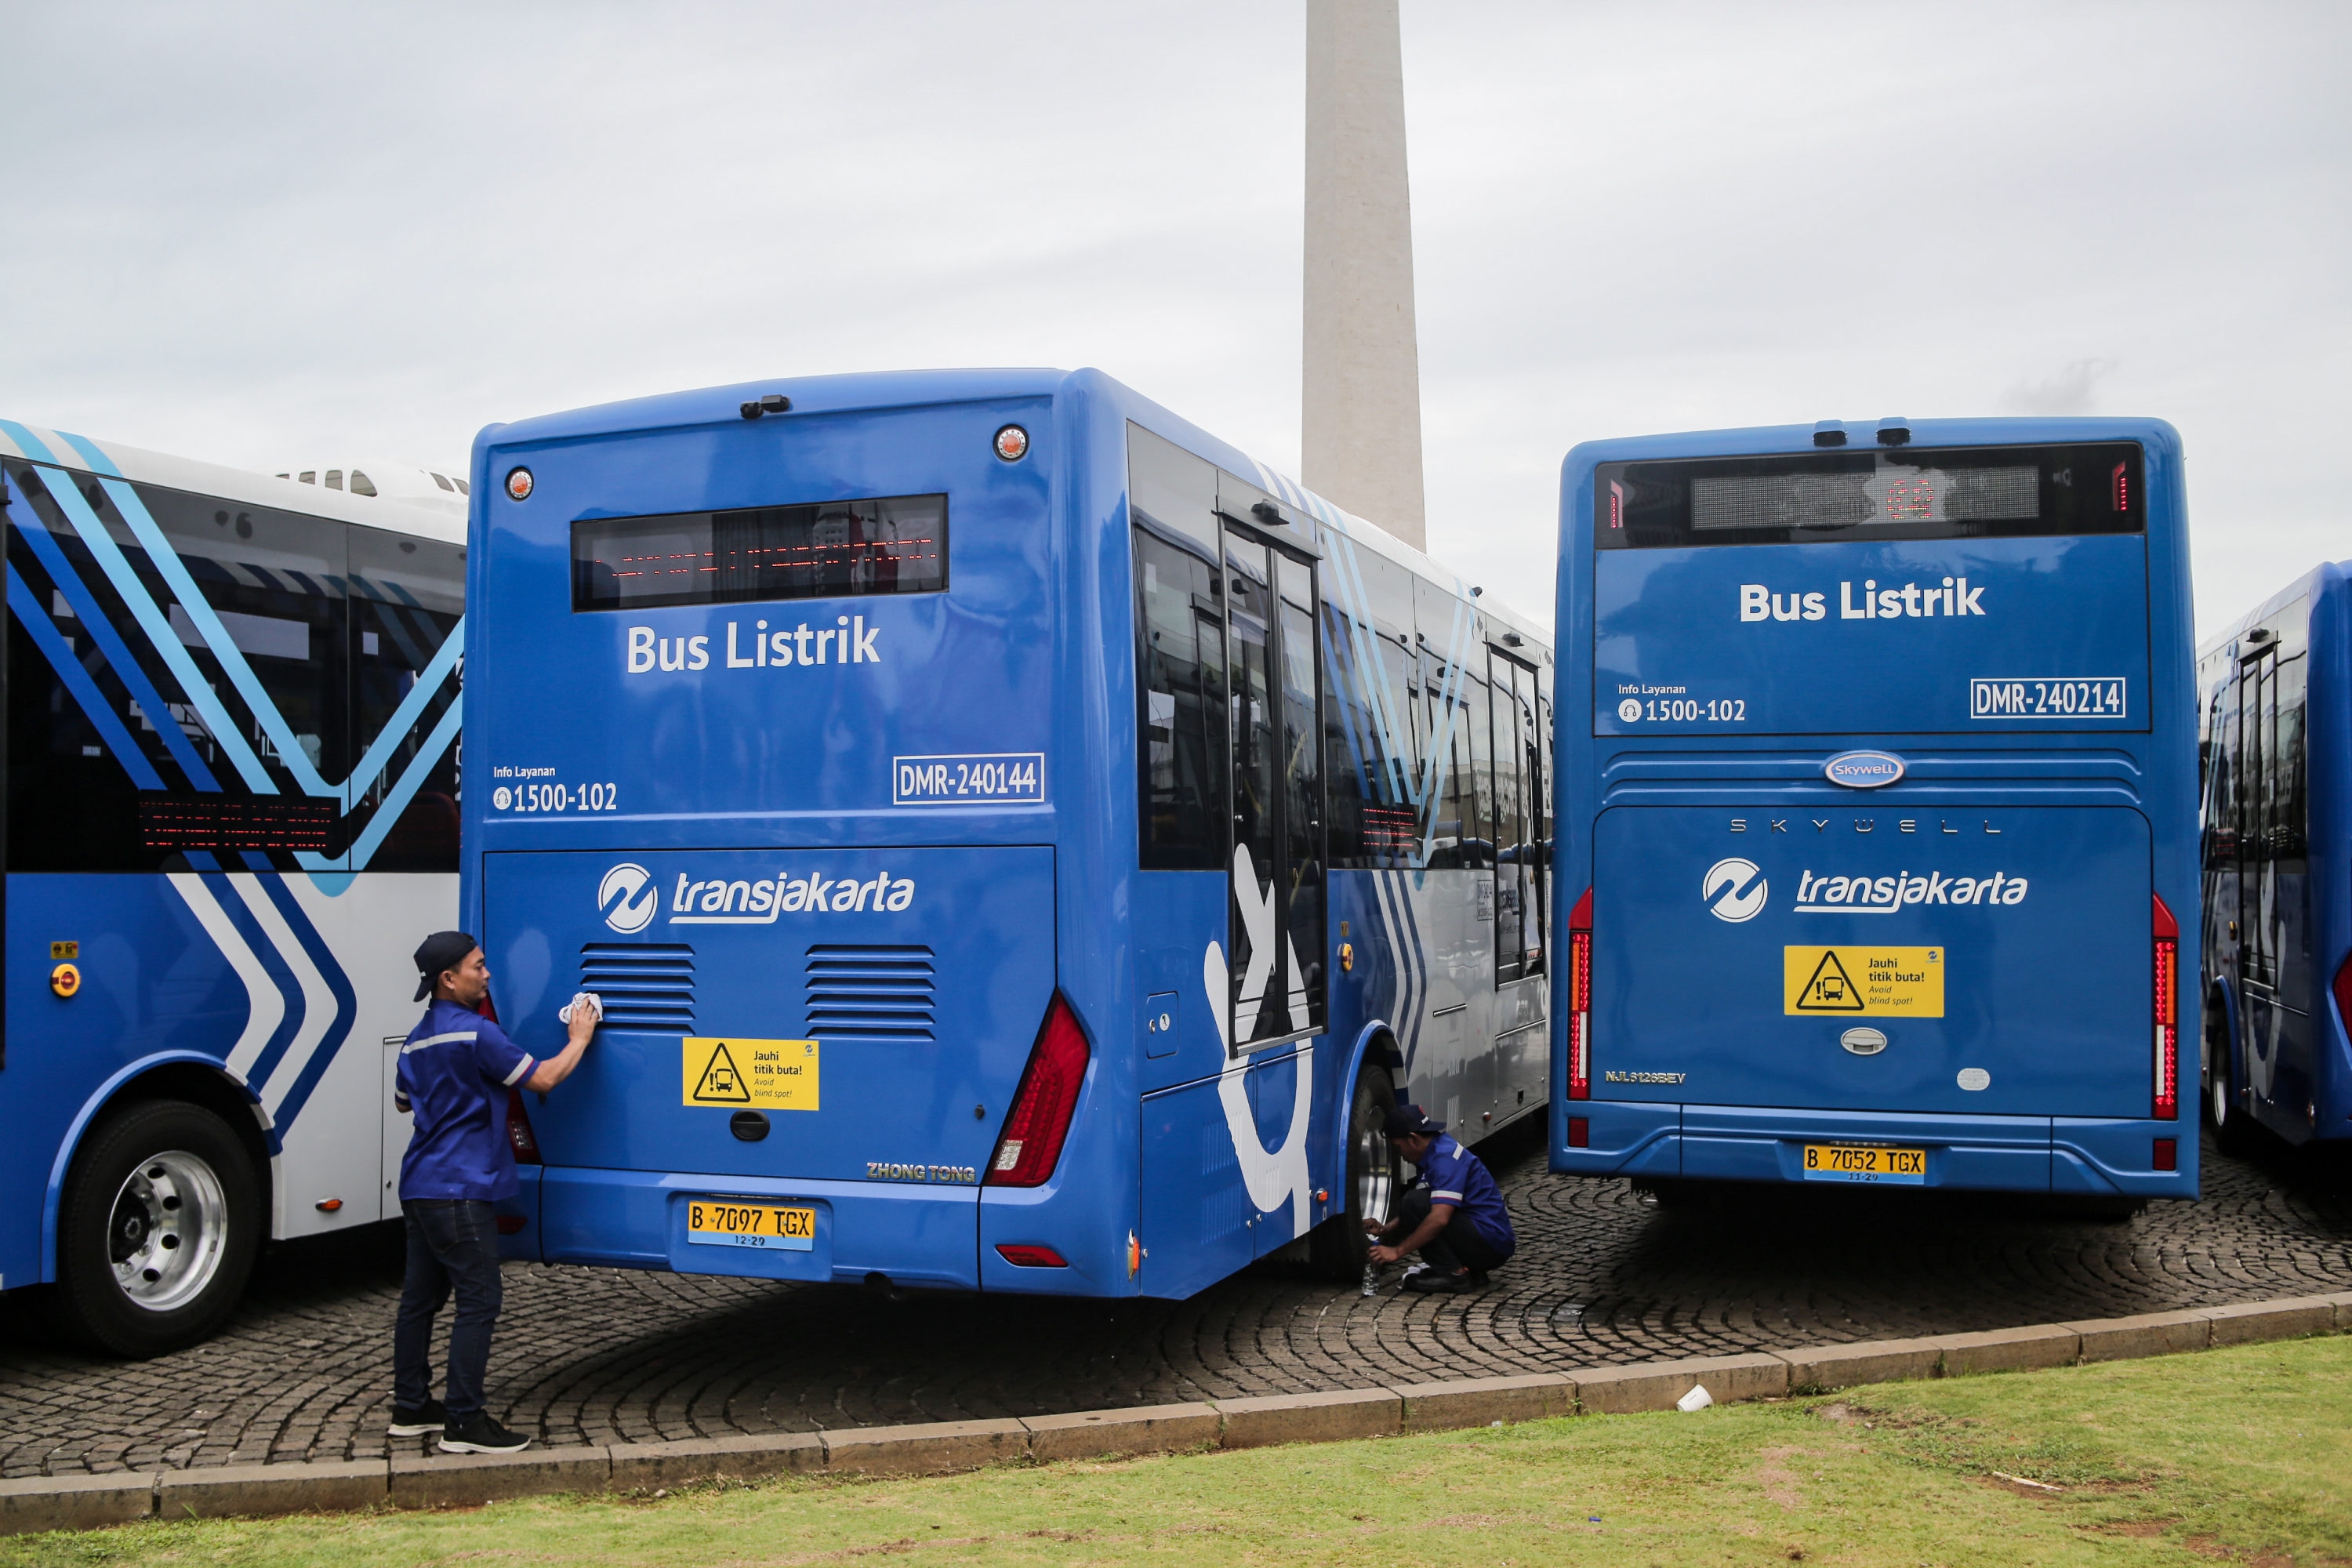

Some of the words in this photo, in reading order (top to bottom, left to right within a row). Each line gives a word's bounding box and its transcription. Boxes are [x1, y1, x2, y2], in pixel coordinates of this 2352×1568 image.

[1740, 584, 1826, 622] Bus
[1840, 576, 1986, 619] Listrik
[627, 626, 710, 673] Bus
[727, 615, 881, 669] Listrik
[1618, 684, 1639, 695] Info
[1642, 684, 1686, 696] Layanan
[1976, 682, 2121, 715] DMR-240214
[1646, 699, 1745, 721] 1500-102
[493, 766, 513, 778] Info
[514, 765, 556, 780] Layanan
[1835, 764, 1895, 776] Skywell
[900, 762, 1036, 796] DMR-240144
[514, 782, 617, 812] 1500-102
[1730, 818, 2001, 833] SKYWELL
[668, 871, 915, 924] transjakarta
[1793, 869, 2028, 914] transjakarta
[1868, 957, 1898, 968] Jauhi
[1868, 971, 1892, 982] titik
[1895, 971, 1925, 982] buta!
[1868, 985, 1893, 994] Avoid
[1868, 996, 1890, 1005] blind
[1892, 996, 1913, 1007] spot!
[753, 1050, 779, 1062] Jauhi
[753, 1063, 775, 1075] titik
[776, 1064, 802, 1076] buta!
[753, 1077, 775, 1087] Avoid
[753, 1088, 773, 1098] blind
[774, 1090, 793, 1100] spot!
[1807, 1149, 1818, 1167] B
[1831, 1149, 1876, 1170] 7052
[1886, 1152, 1922, 1172] TGX
[866, 1163, 926, 1180] ZHONG
[928, 1165, 975, 1182] TONG
[1848, 1172, 1878, 1181] 11-29
[691, 1206, 703, 1229] B
[715, 1207, 763, 1232] 7097
[774, 1211, 810, 1237] TGX
